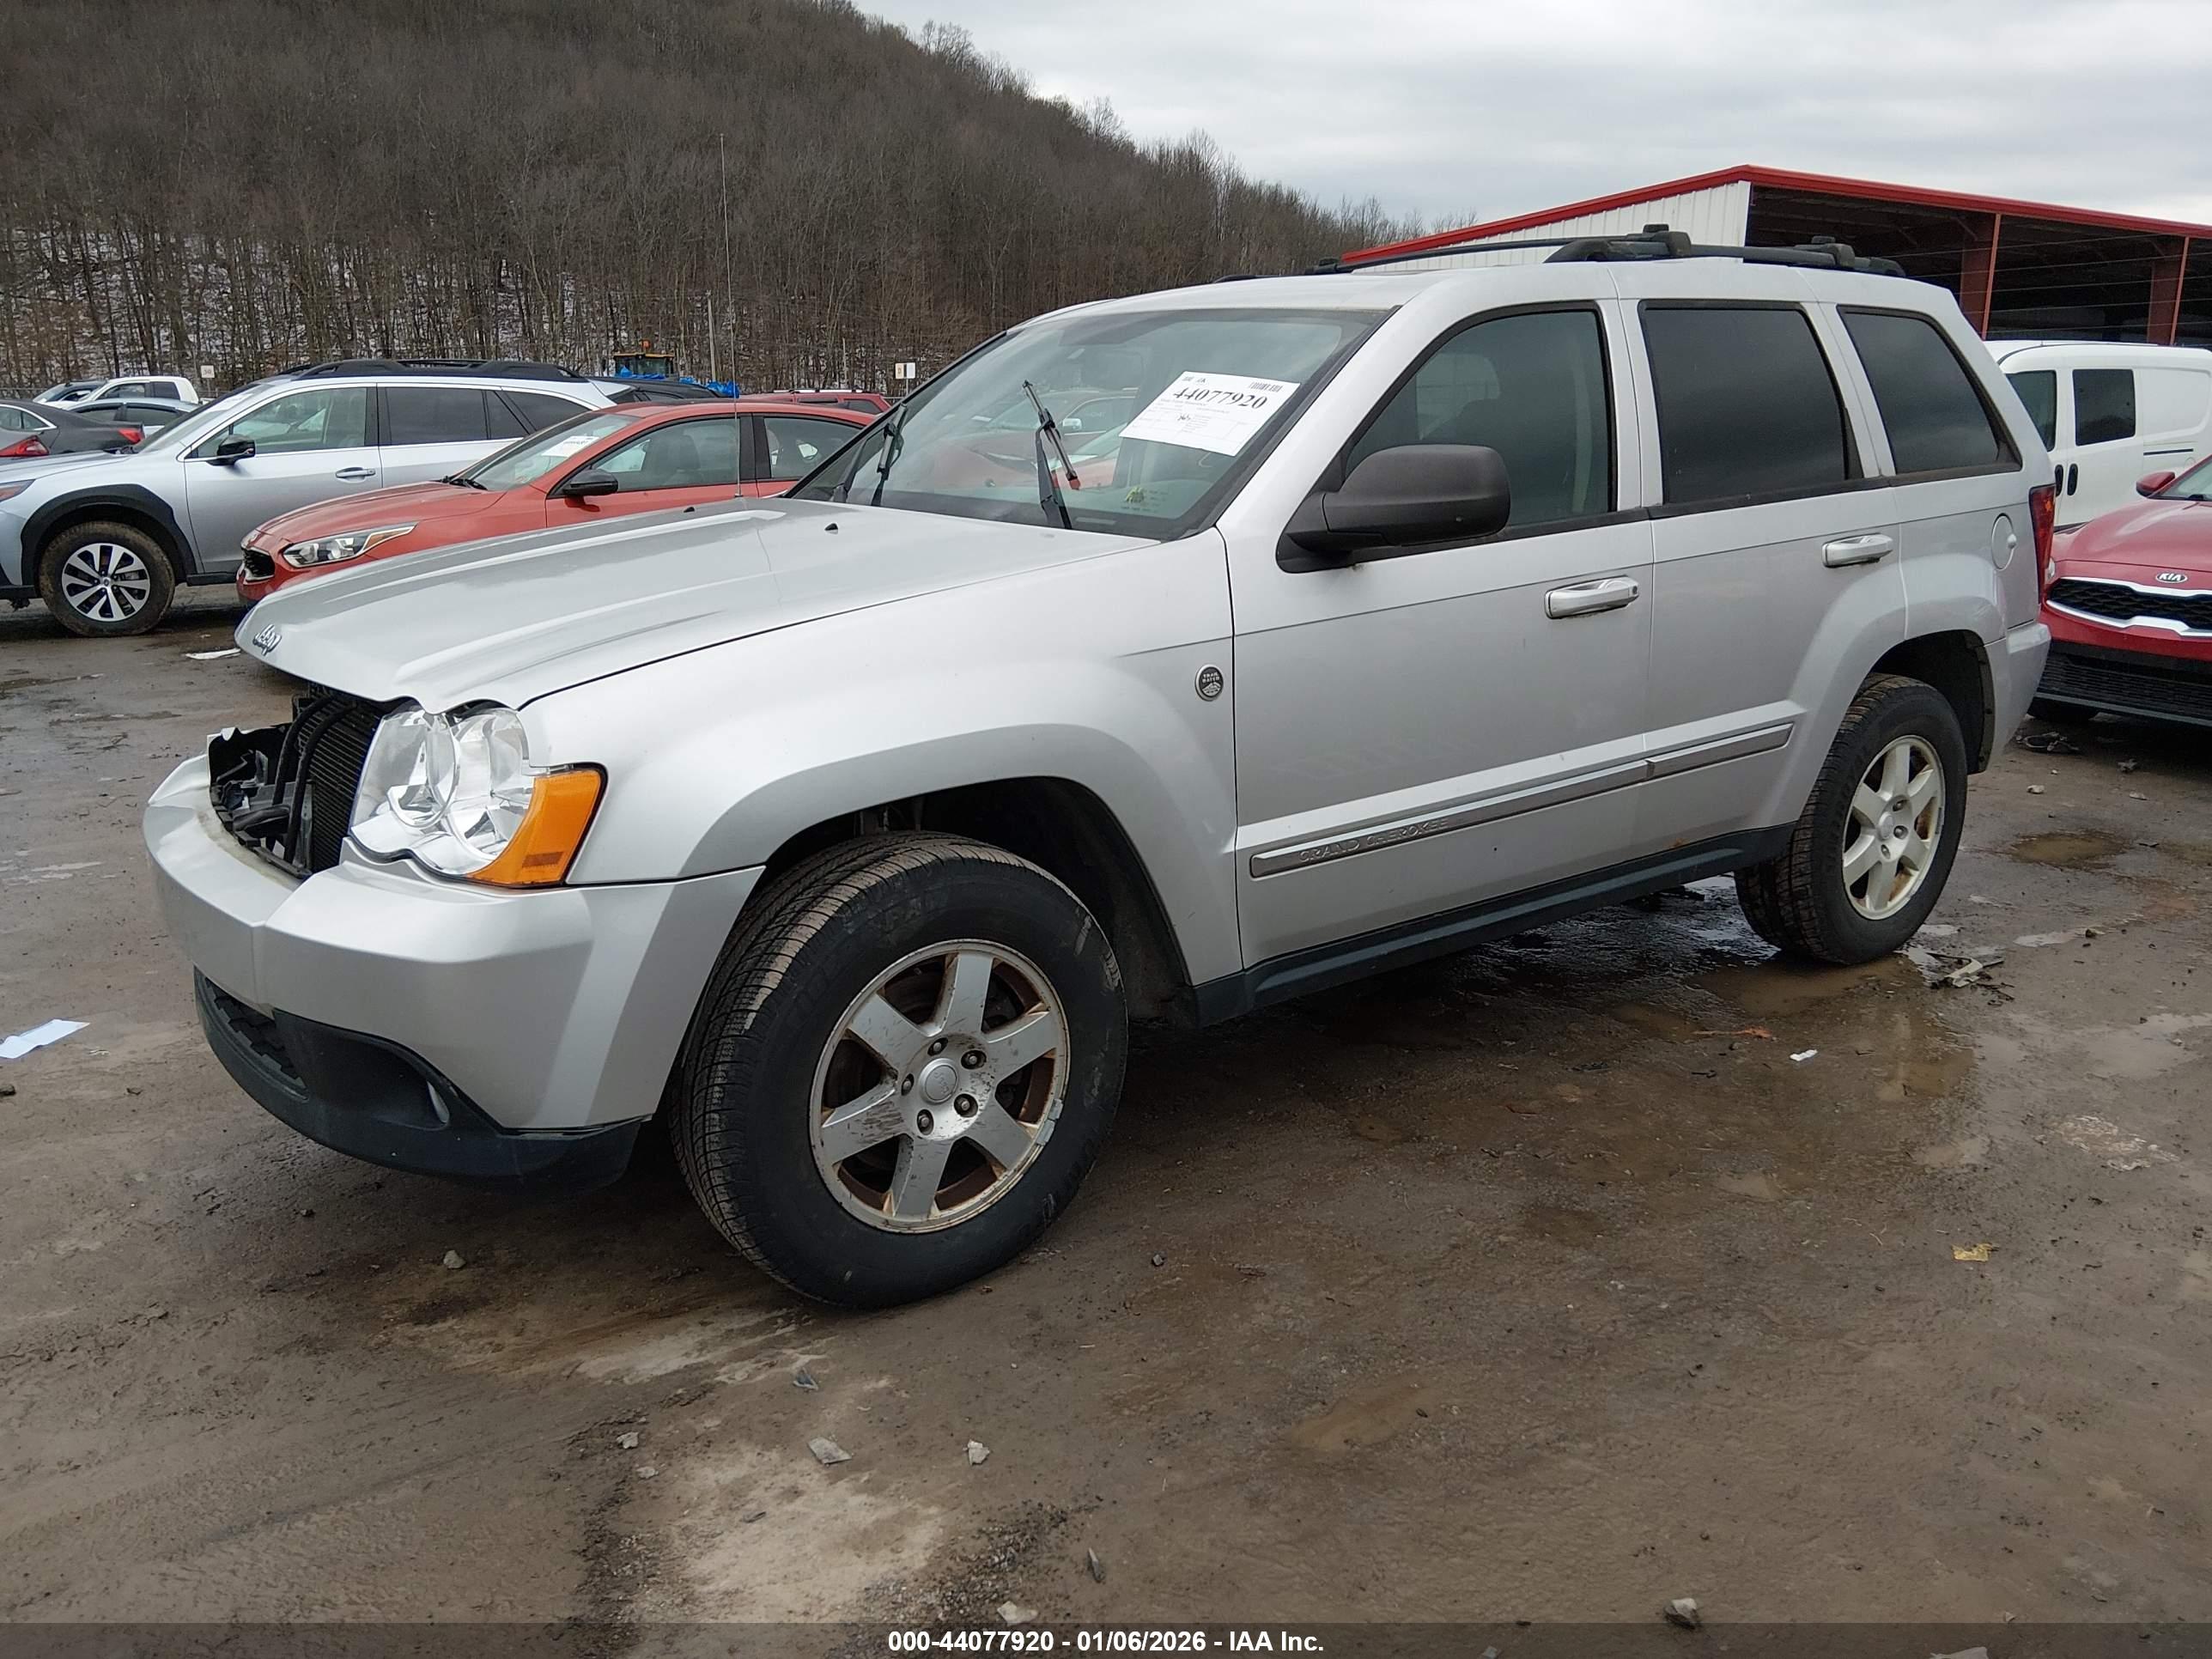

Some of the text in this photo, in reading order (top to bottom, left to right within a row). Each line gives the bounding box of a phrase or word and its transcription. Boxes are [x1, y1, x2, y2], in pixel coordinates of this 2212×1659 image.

[1173, 386, 1268, 410] 44077920
[2159, 573, 2182, 581] KIA
[1299, 817, 1449, 863] GRAND CHEROKEE
